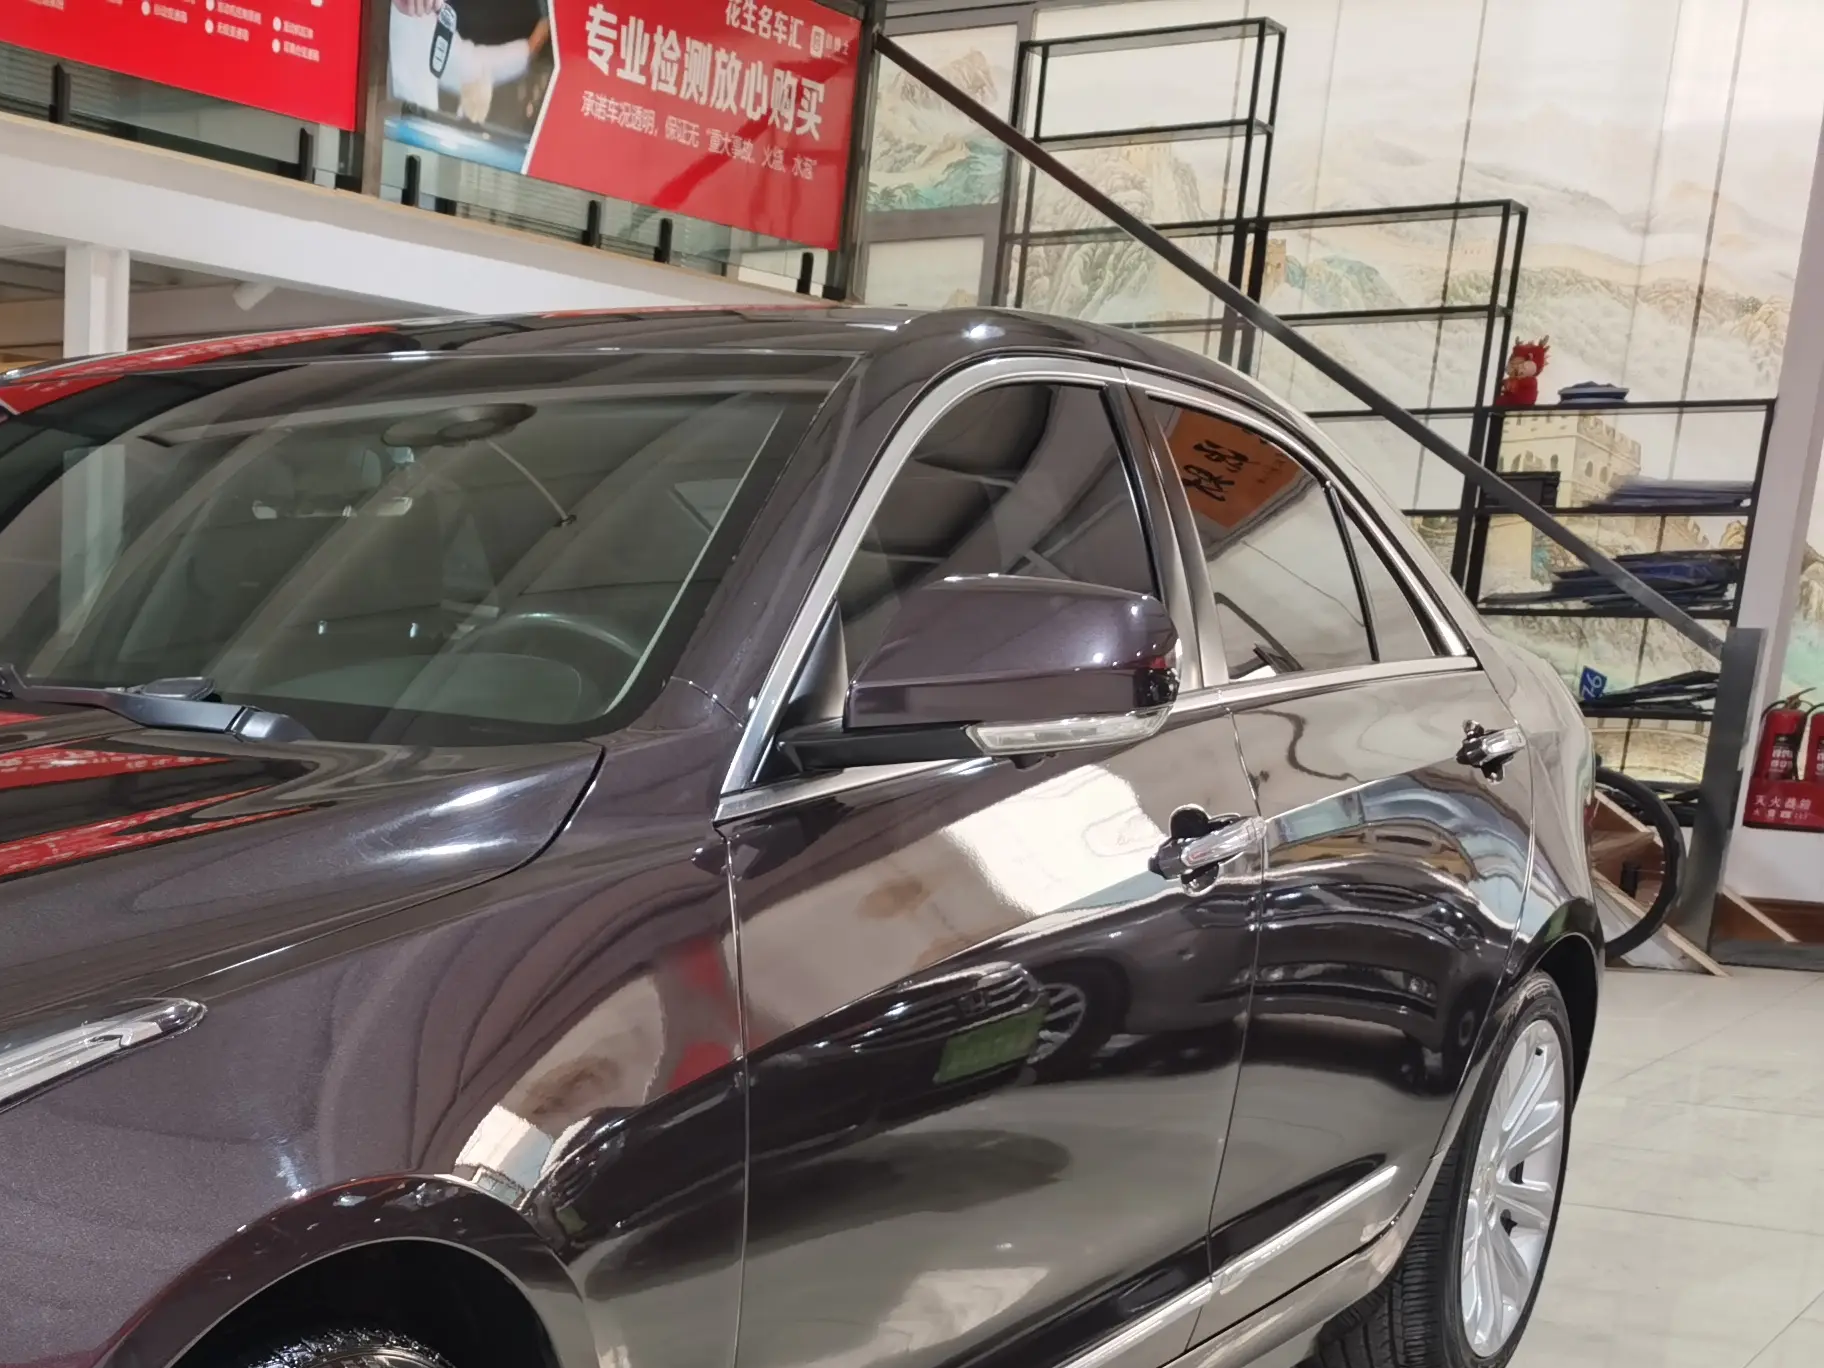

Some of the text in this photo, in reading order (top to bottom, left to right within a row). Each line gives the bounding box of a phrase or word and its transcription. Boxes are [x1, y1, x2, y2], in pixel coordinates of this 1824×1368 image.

[585, 3, 825, 141] 专业检测放心购买
[725, 0, 804, 50] 花生名车汇
